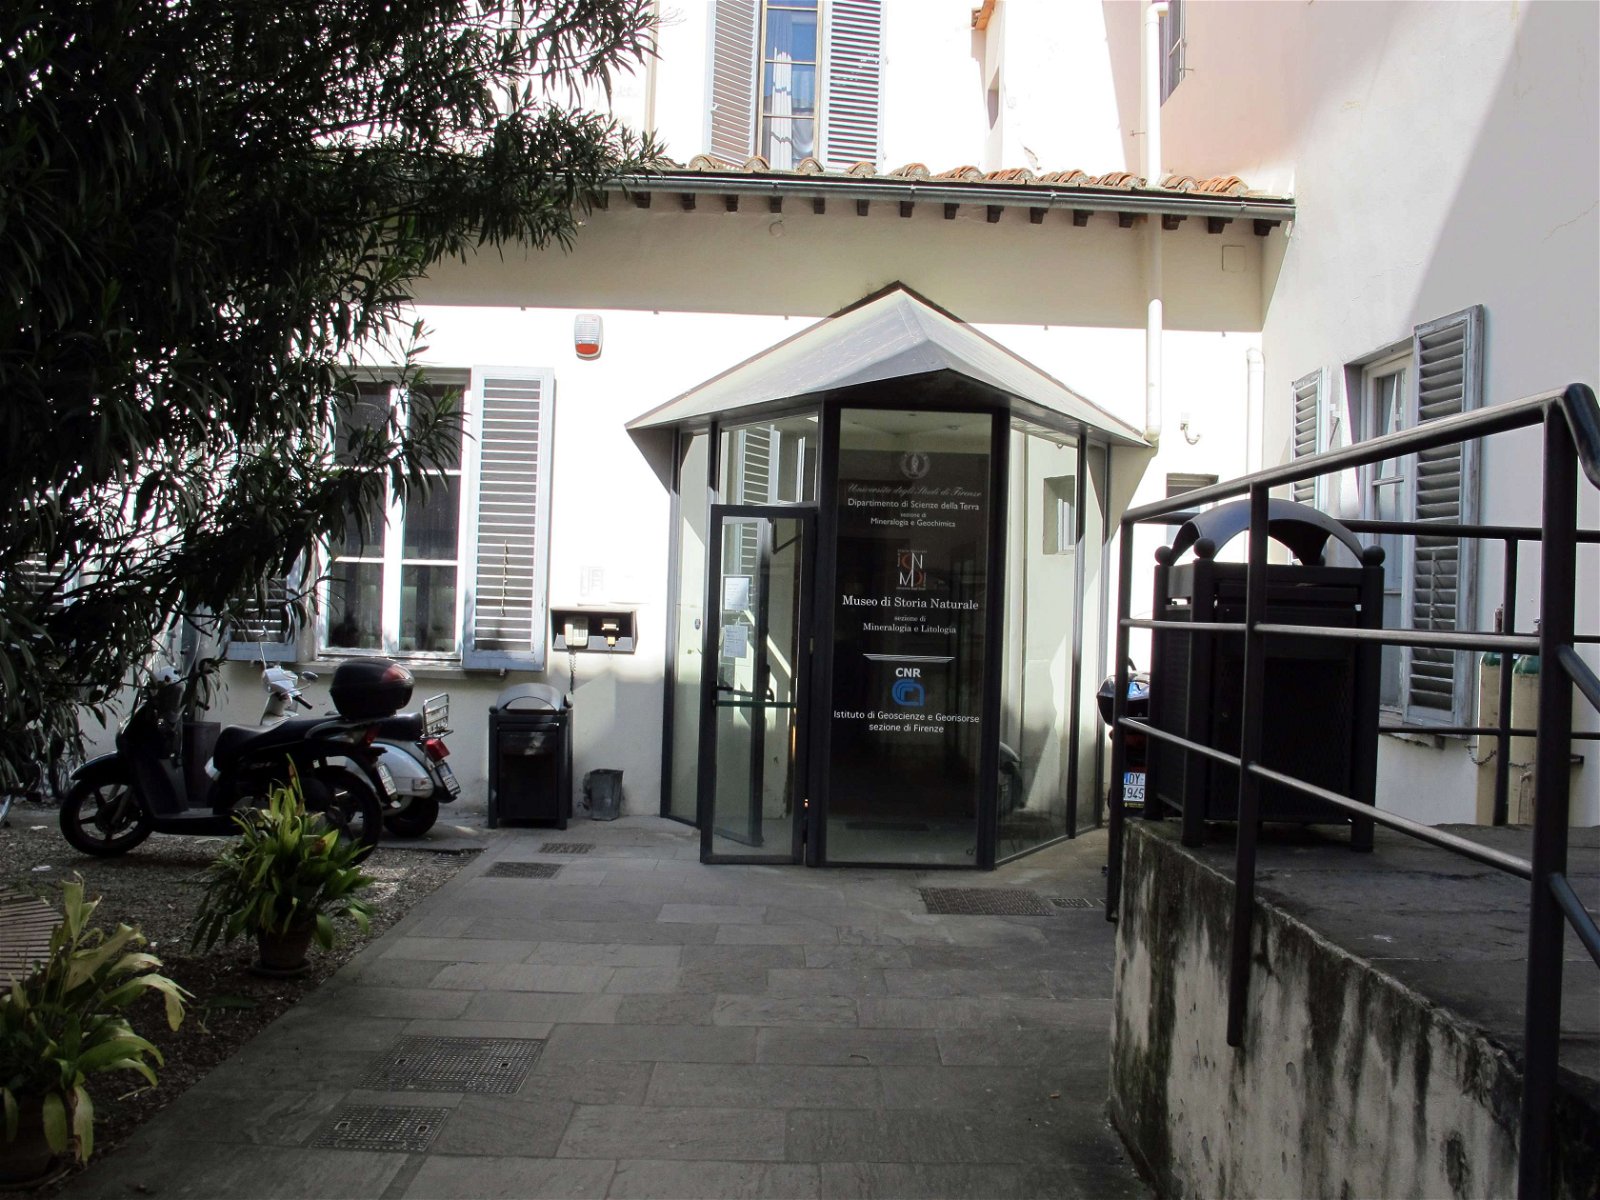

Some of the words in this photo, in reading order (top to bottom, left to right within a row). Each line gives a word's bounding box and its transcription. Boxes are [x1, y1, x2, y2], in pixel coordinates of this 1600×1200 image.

[951, 486, 983, 497] Firenze
[847, 498, 899, 508] Dipartimento
[901, 500, 909, 508] di
[910, 501, 939, 509] Scienze
[941, 502, 958, 510] della
[959, 502, 980, 511] Terra
[870, 517, 909, 528] Mineralogia
[916, 519, 956, 528] Geochimica
[842, 595, 878, 606] Museo
[880, 596, 891, 607] di
[894, 597, 927, 608] Storia
[930, 598, 979, 610] Naturale
[863, 622, 912, 633] Mineralogia
[921, 624, 957, 635] Litologia
[895, 667, 921, 678] CNR
[833, 710, 865, 719] Istituto
[867, 711, 875, 719] di
[877, 711, 925, 721] Geoscienze
[935, 713, 980, 723] Georisorse
[868, 724, 901, 732] sezione
[903, 723, 912, 732] di
[913, 724, 944, 733] Firenze
